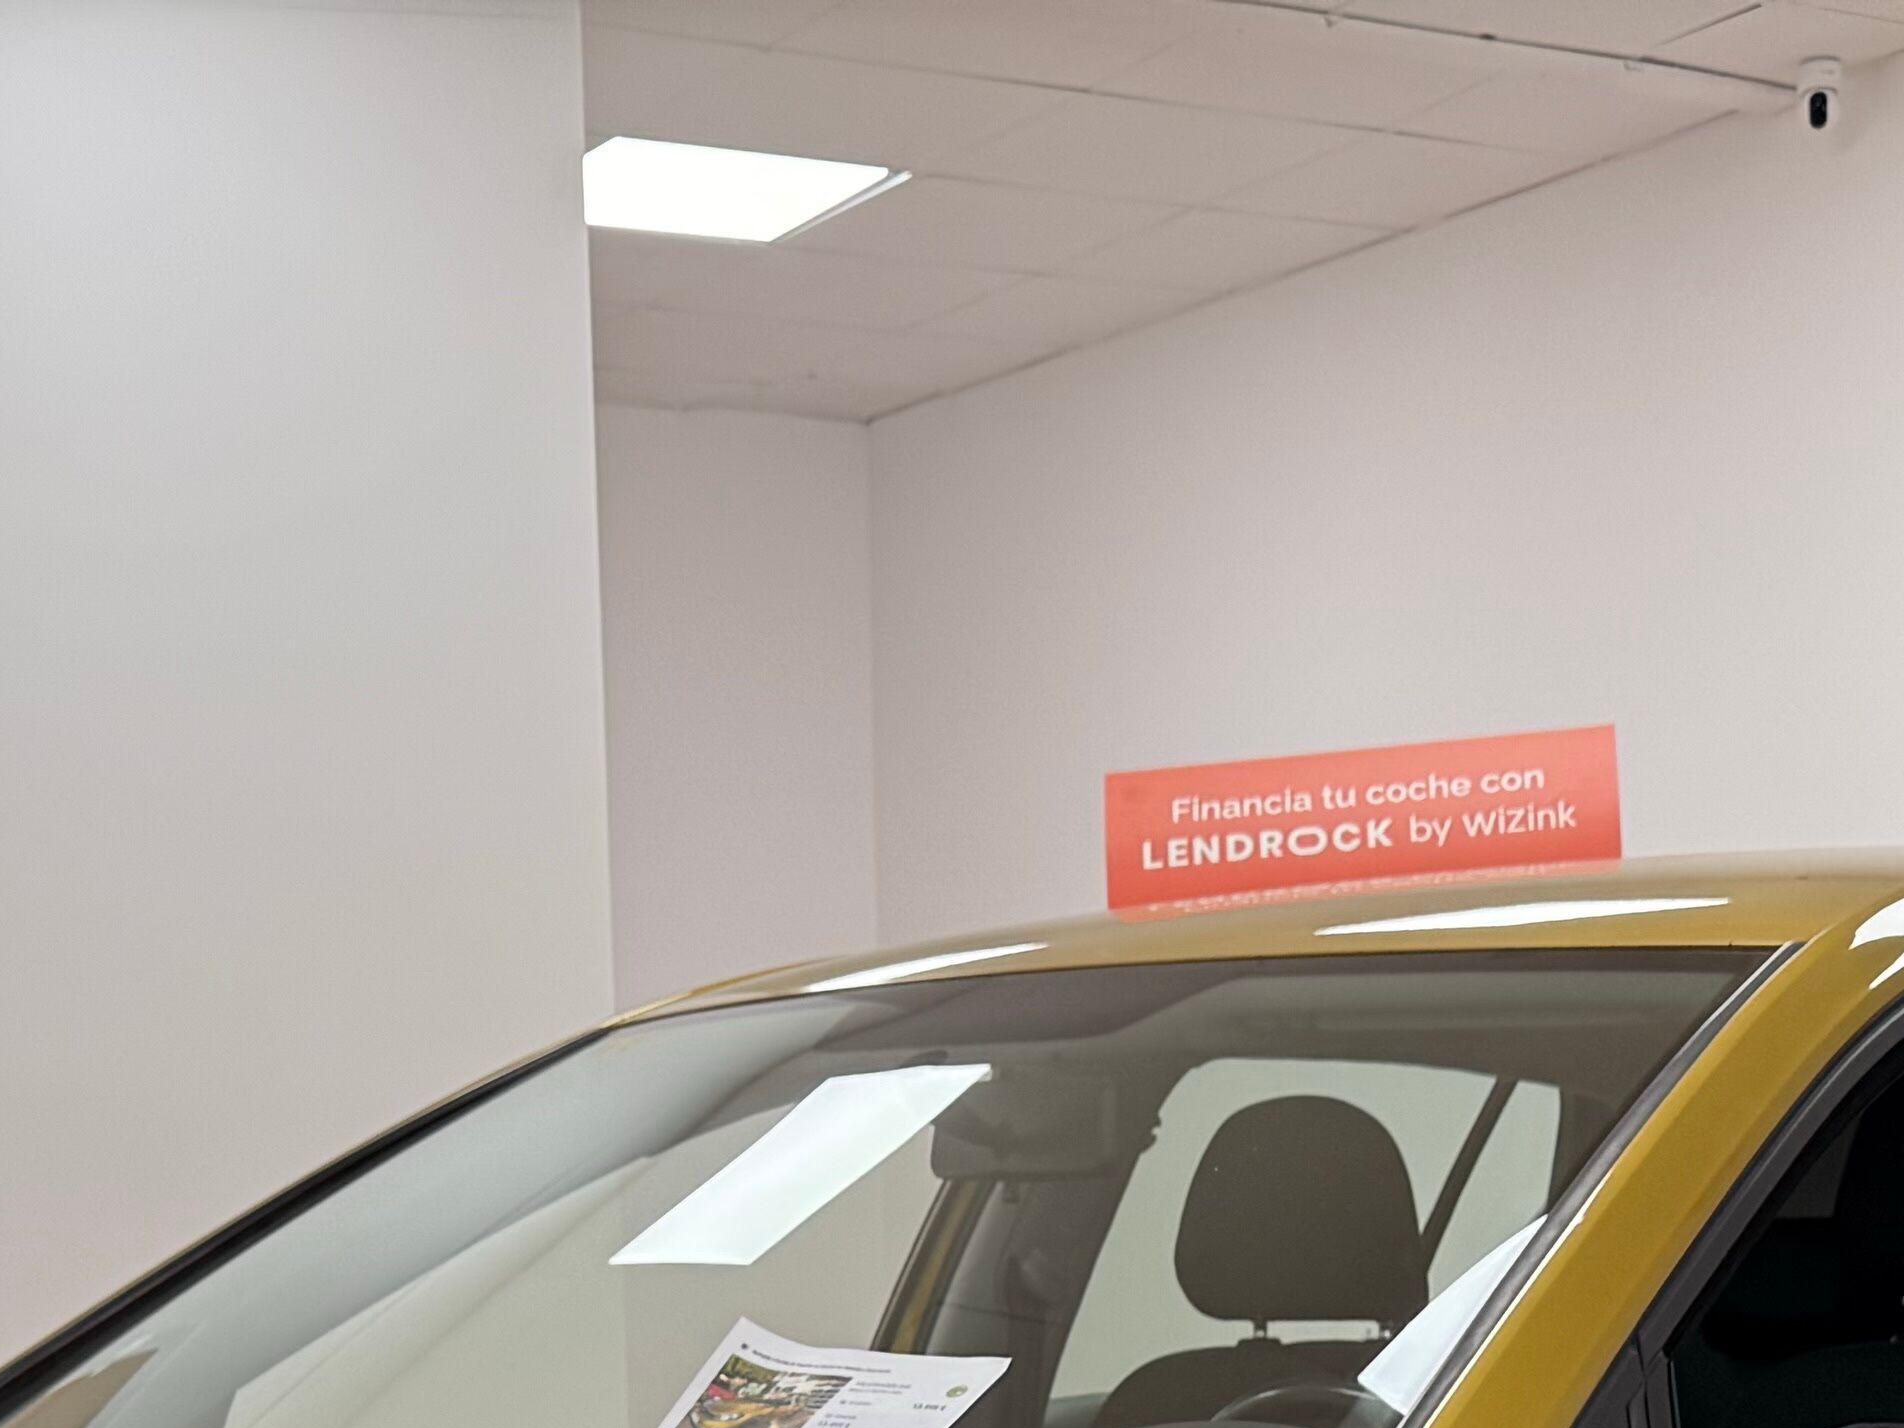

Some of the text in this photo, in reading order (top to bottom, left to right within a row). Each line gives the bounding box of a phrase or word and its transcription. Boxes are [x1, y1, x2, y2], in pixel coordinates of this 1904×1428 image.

[1170, 767, 1545, 825] Financia tu coche con
[1141, 817, 1393, 871] LENDROCK
[1408, 812, 1453, 848] by
